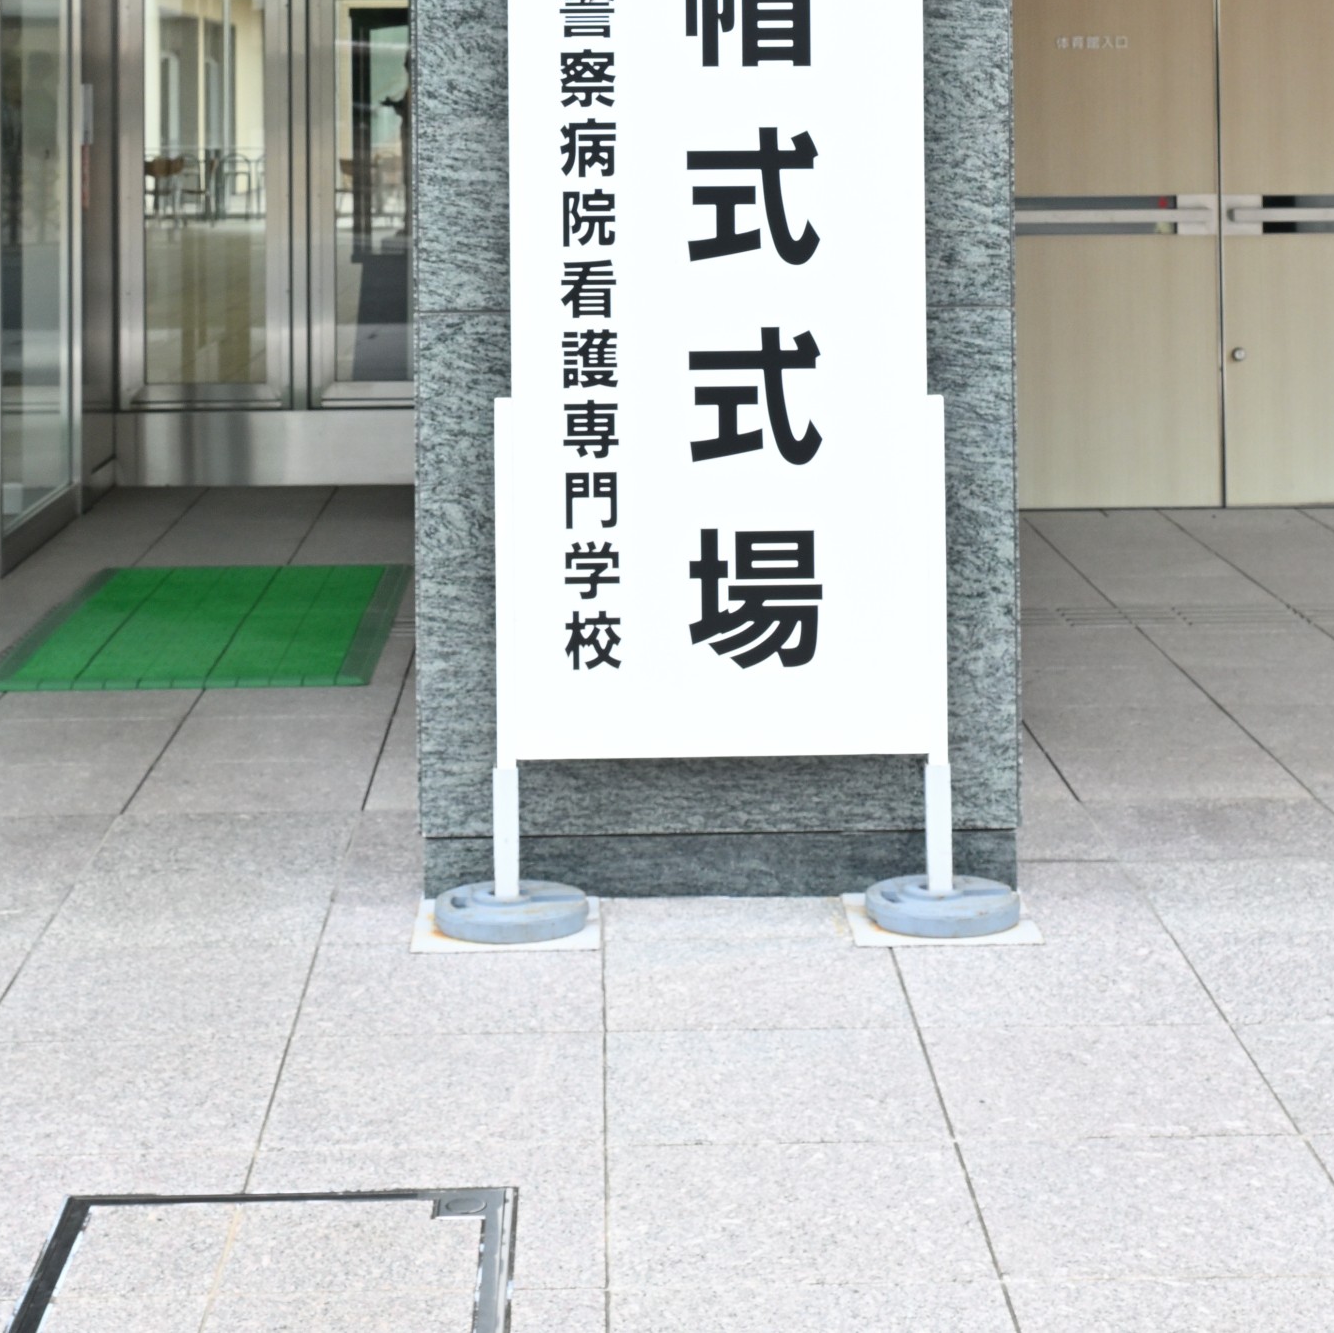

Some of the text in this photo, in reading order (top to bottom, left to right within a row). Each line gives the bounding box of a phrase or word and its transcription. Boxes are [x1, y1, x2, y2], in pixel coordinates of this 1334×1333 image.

[1056, 35, 1129, 50] 体育館入口
